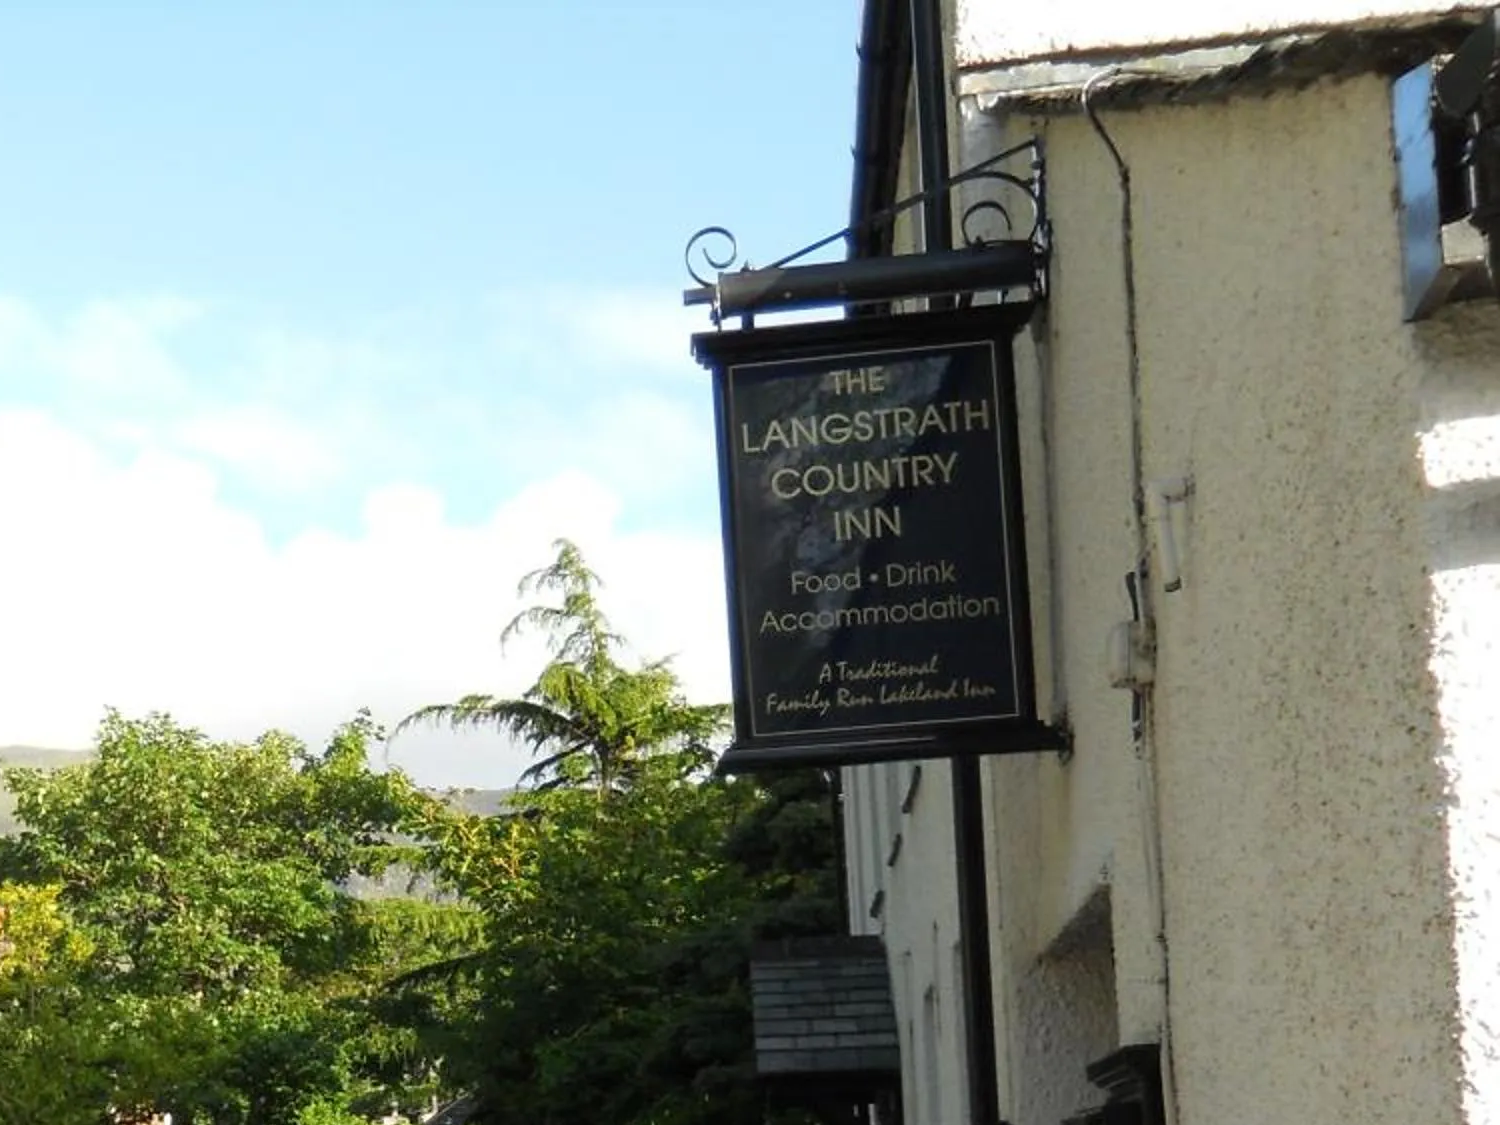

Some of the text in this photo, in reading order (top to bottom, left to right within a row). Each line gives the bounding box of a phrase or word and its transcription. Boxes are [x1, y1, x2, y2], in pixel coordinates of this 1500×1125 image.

[830, 366, 885, 395] THE
[741, 399, 990, 453] LANGSTRATH
[771, 452, 958, 499] COUNTRY
[834, 506, 901, 541] INN
[791, 560, 956, 595] Food Drink
[760, 596, 1000, 633] Accommodation
[819, 654, 939, 684] A Traditional
[766, 677, 996, 717] Family Run Lakeland Inn
